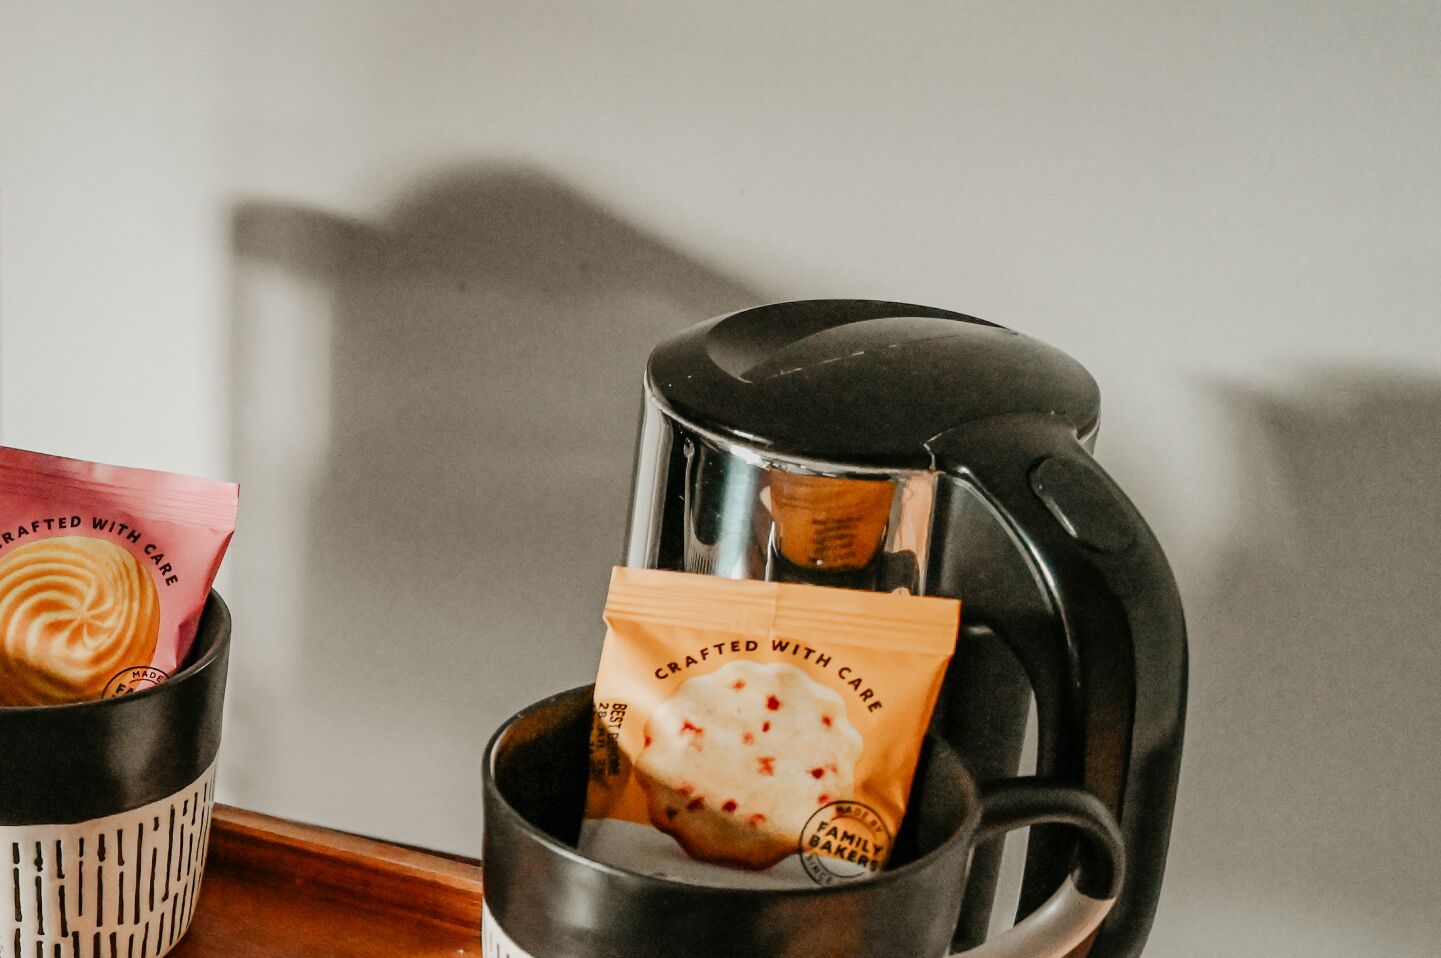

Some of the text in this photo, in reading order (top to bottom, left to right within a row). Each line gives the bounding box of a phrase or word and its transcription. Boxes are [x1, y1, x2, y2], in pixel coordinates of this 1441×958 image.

[92, 517, 142, 544] WITH
[144, 543, 179, 587] CARE
[132, 670, 164, 683] MADE
[654, 640, 882, 713] CRAFTED WITH CARE
[607, 703, 628, 729] BEST
[809, 833, 879, 872] BAKERS
[817, 821, 884, 856] FAMILY
